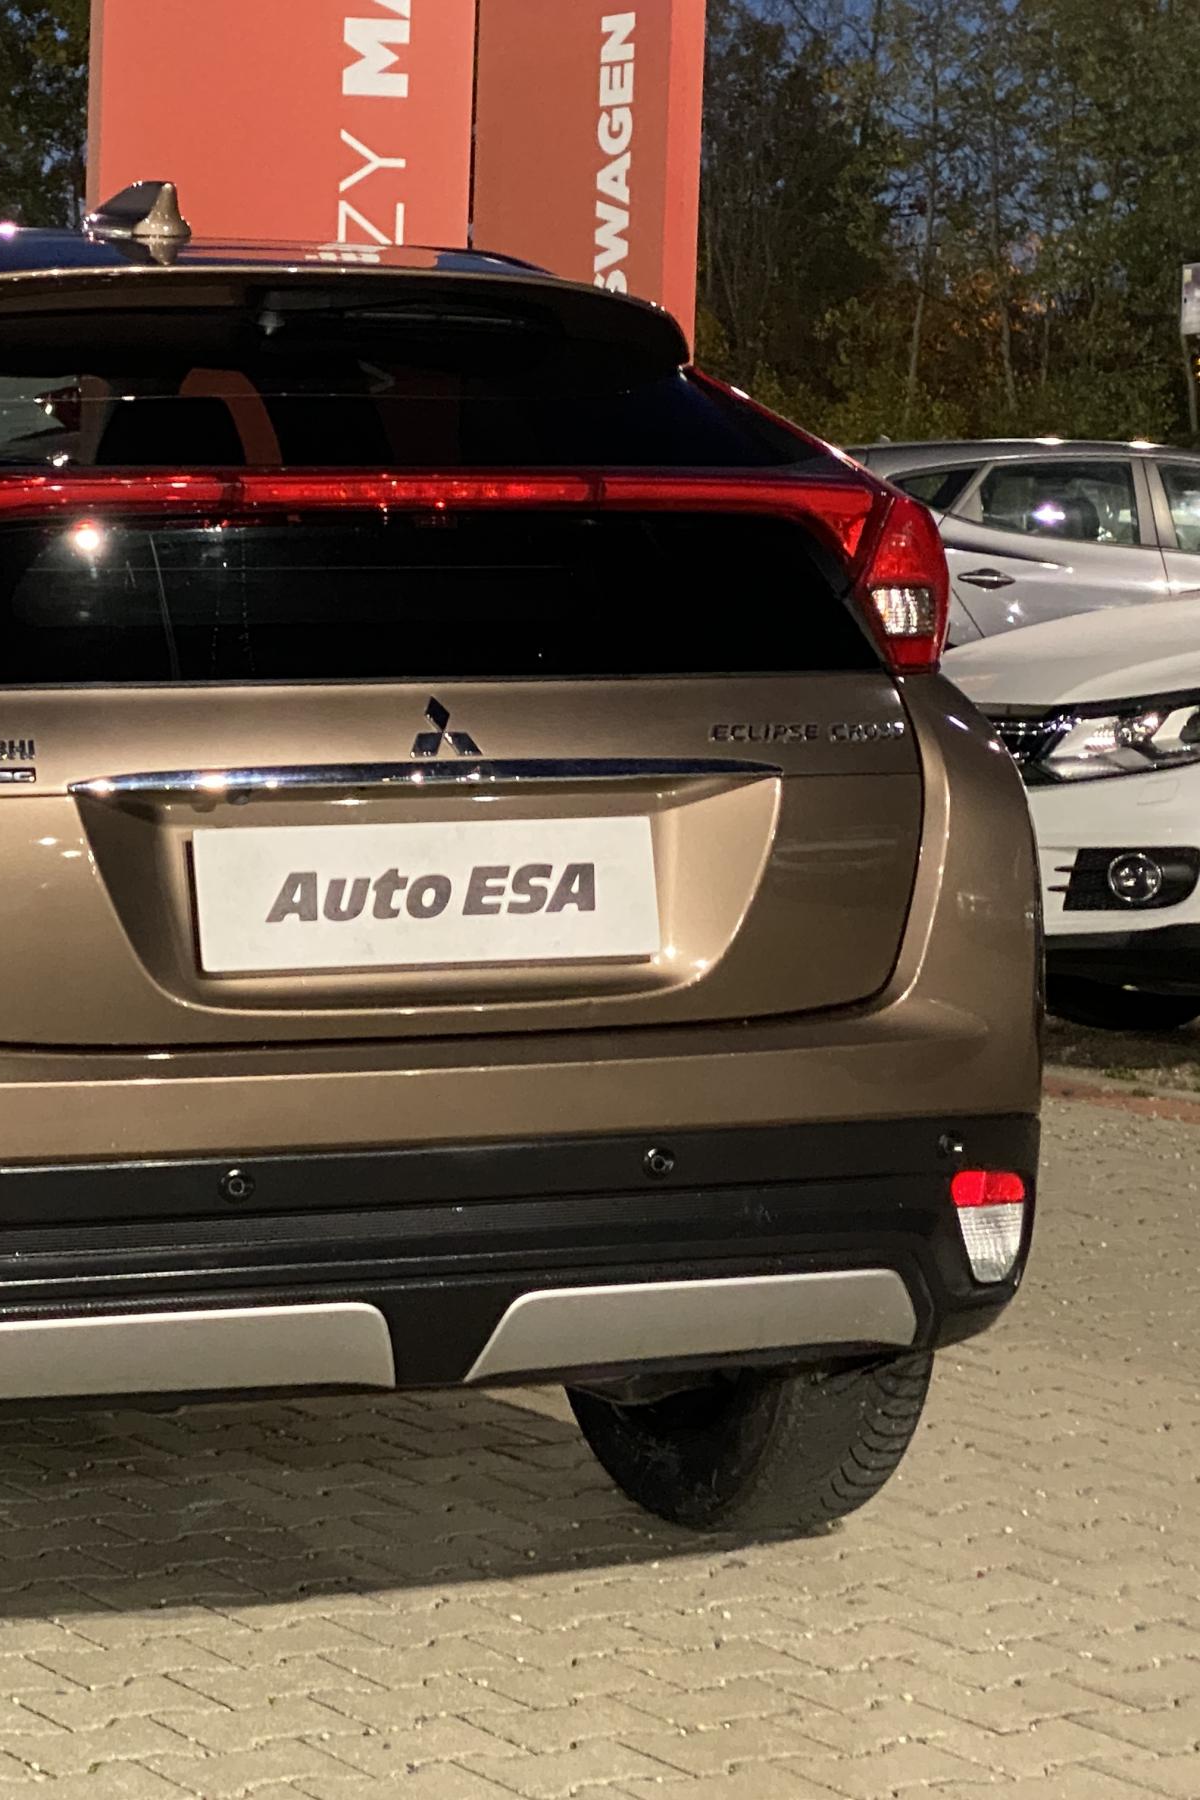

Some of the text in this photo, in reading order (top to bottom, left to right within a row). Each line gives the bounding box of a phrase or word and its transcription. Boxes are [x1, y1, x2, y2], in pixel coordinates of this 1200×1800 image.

[341, 0, 411, 98] M
[710, 723, 819, 744] ECLIPSE
[265, 862, 596, 923] Auto ESA
